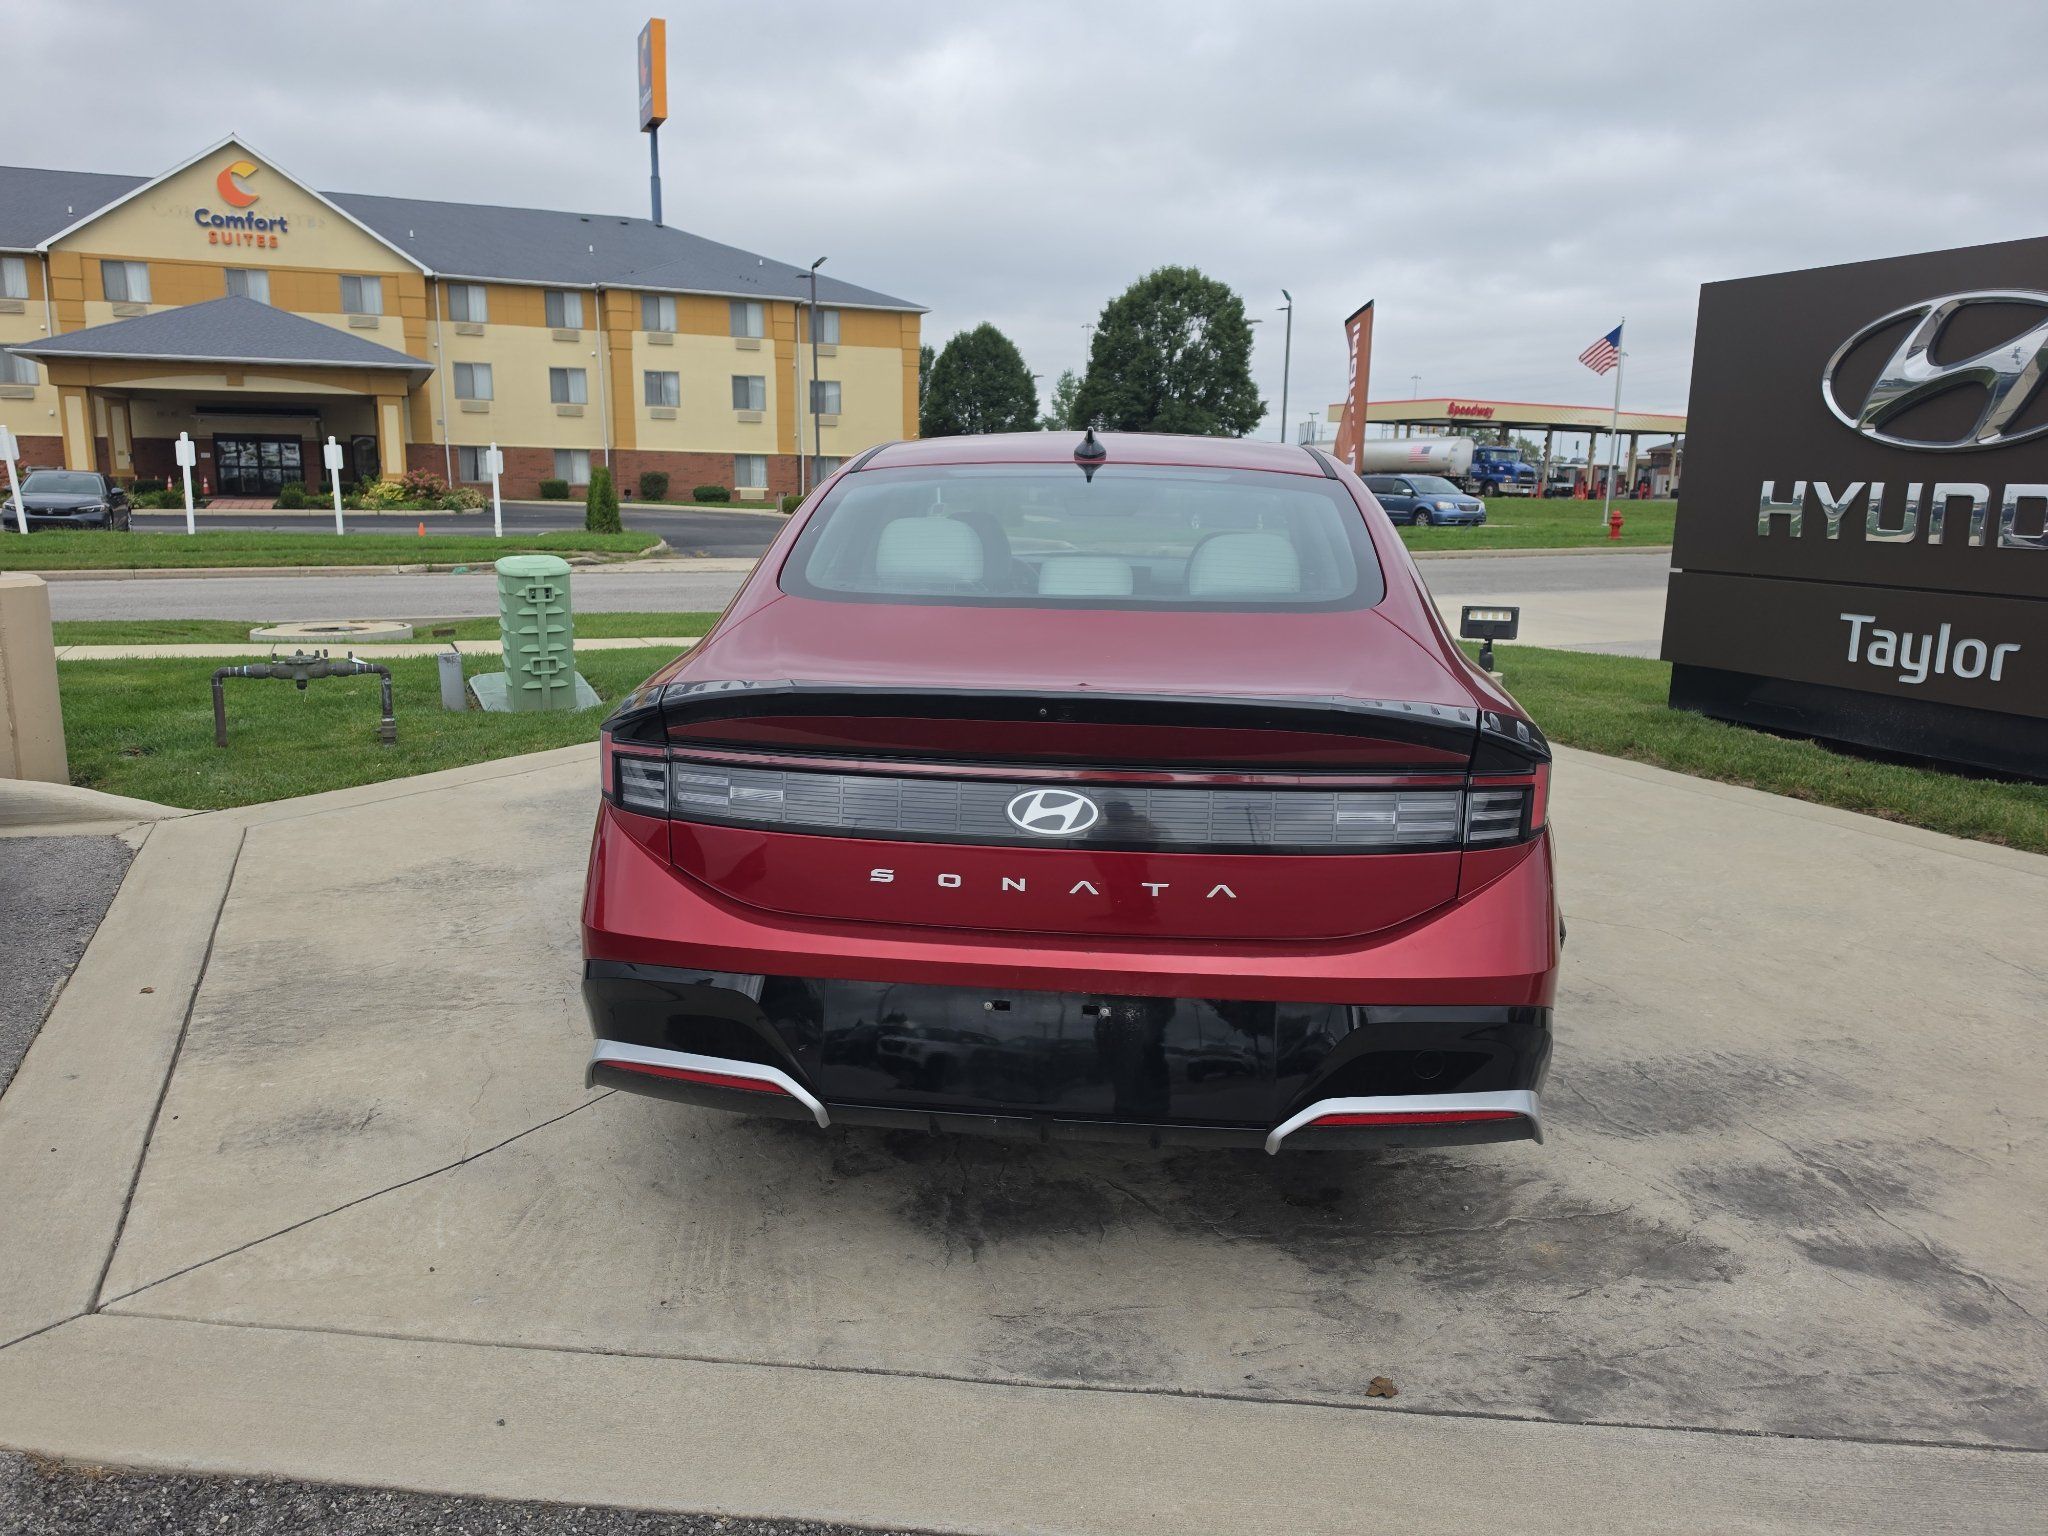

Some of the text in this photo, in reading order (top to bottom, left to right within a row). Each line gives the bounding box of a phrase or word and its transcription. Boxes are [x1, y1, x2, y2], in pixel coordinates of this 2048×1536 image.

[194, 208, 288, 233] Comfort
[208, 231, 278, 249] SUITES
[1446, 401, 1495, 419] Speedway
[1840, 612, 2022, 685] Taylor
[869, 868, 1237, 899] SONATA
